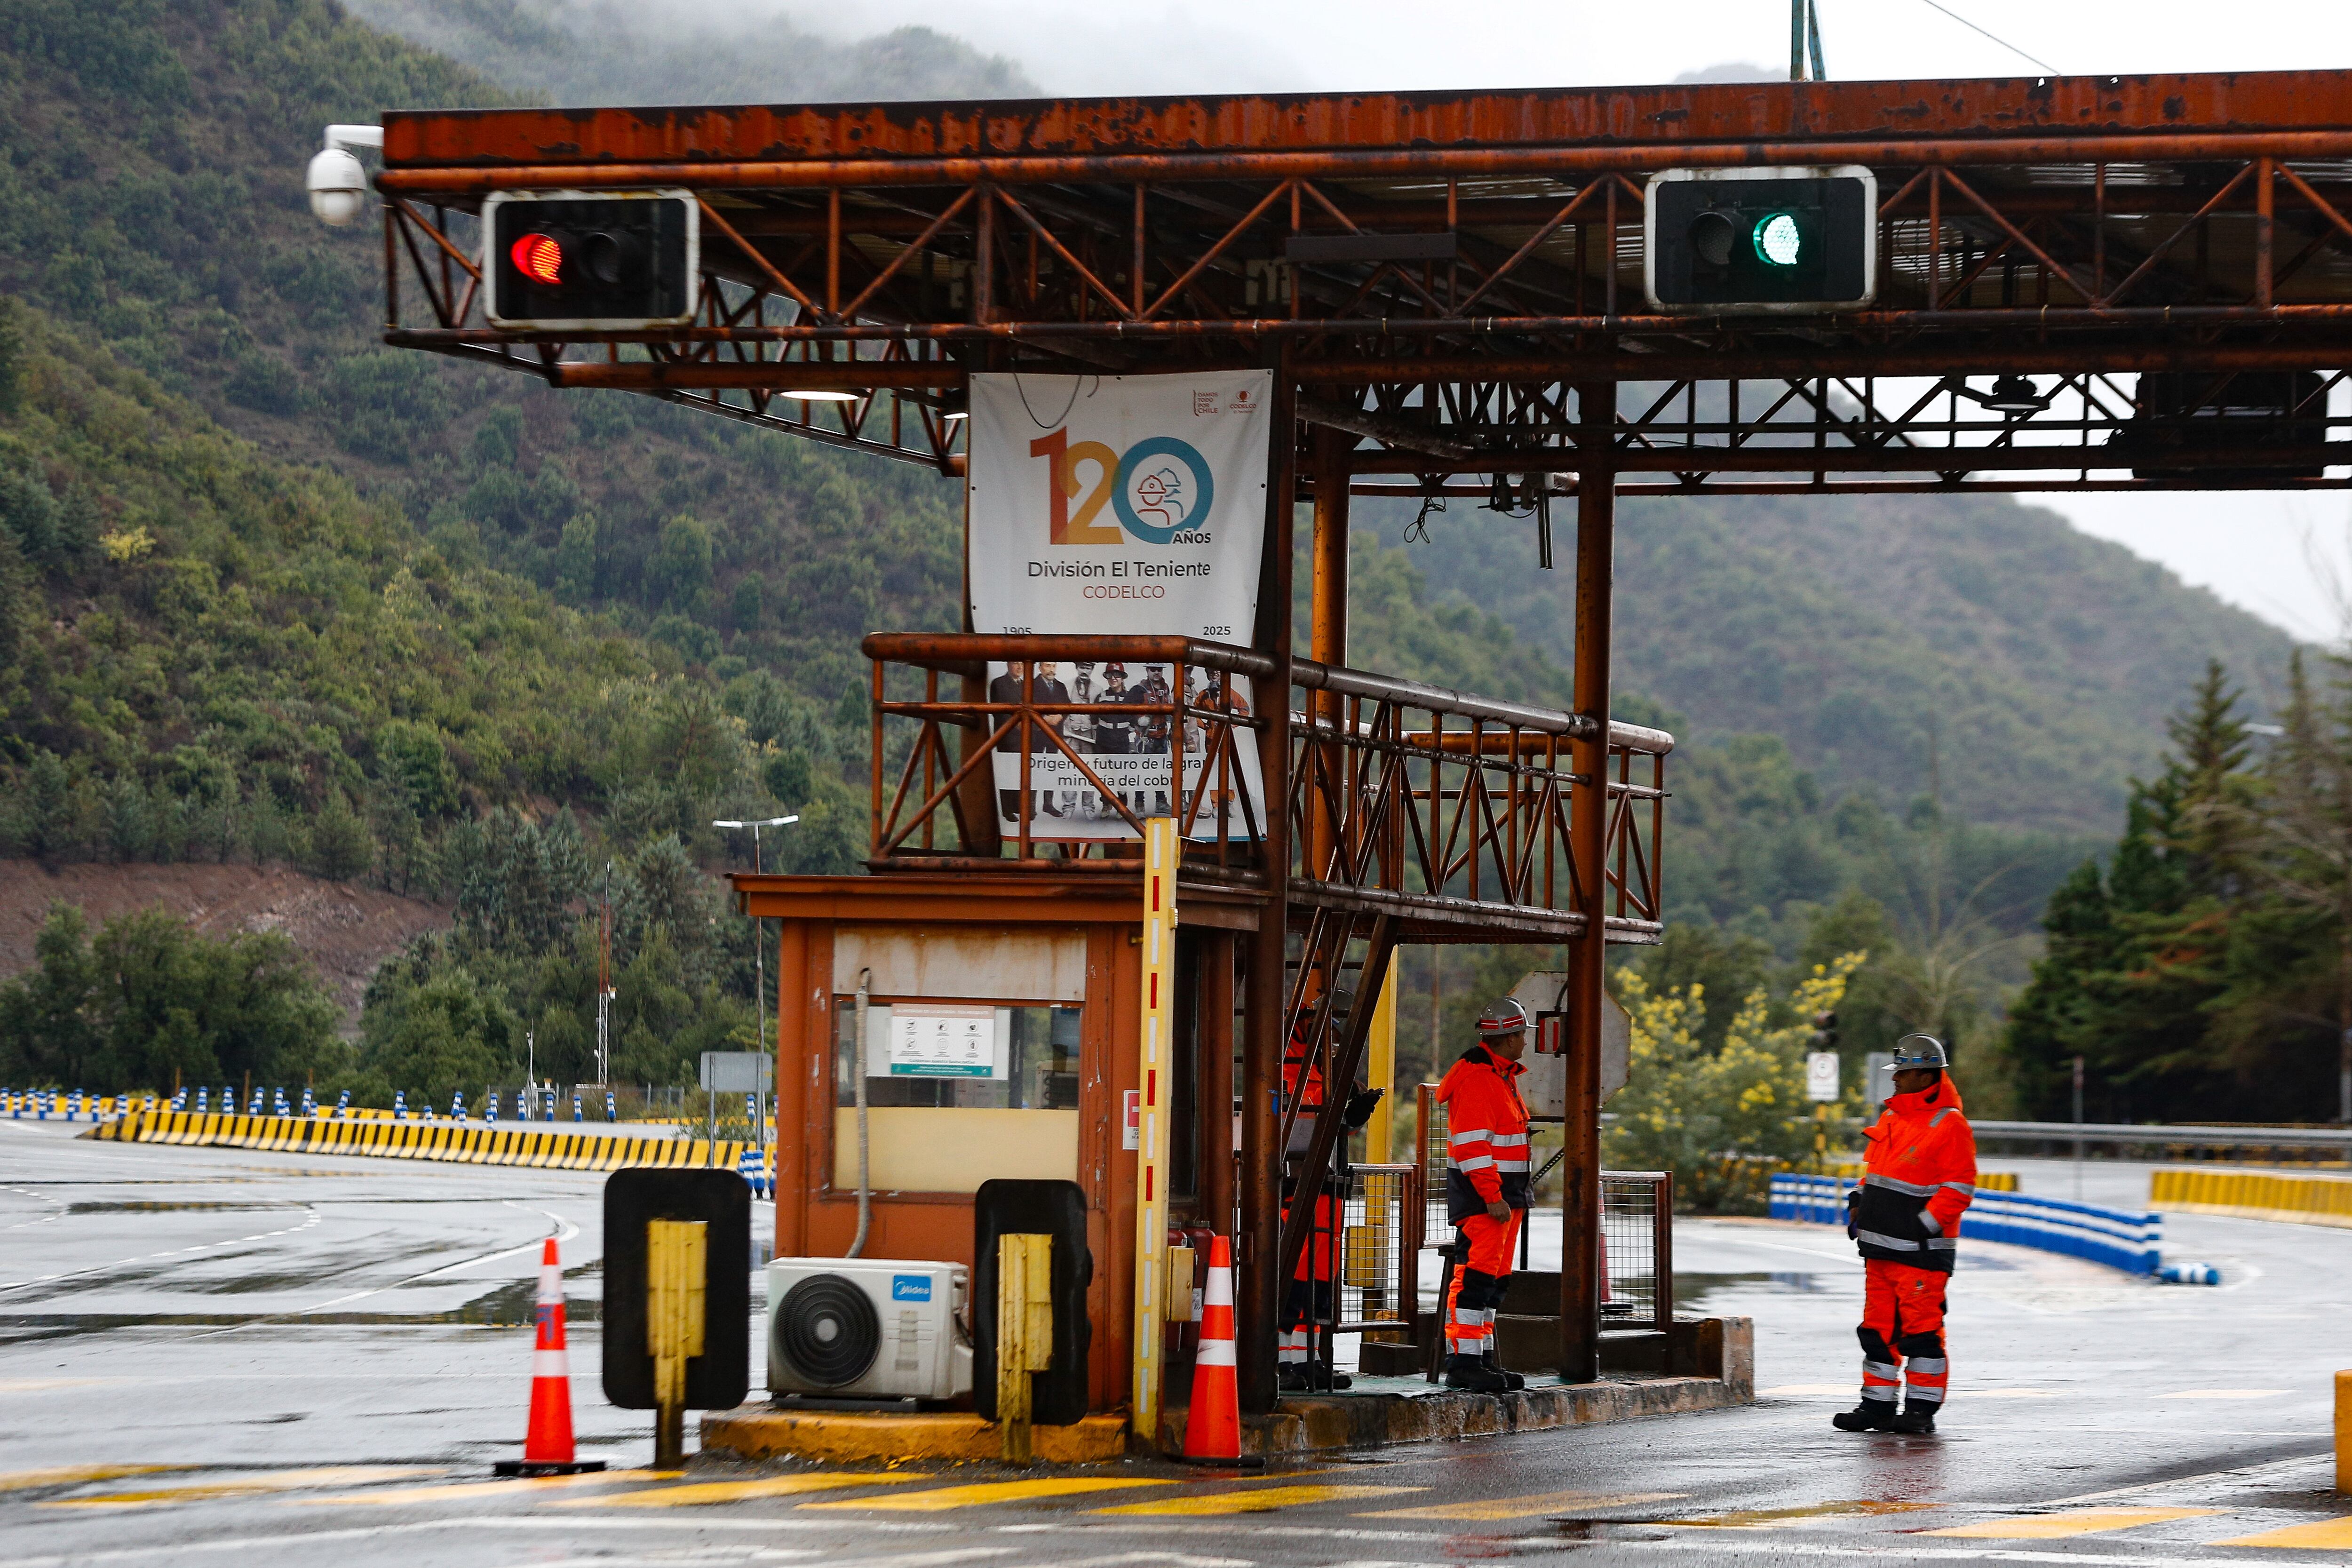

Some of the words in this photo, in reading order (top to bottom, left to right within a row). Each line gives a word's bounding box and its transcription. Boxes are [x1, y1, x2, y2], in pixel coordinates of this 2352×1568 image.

[1031, 426, 1214, 544] 120
[1173, 530, 1211, 544] AÑOS
[1028, 560, 1104, 577] División
[1112, 561, 1128, 577] El
[1133, 560, 1210, 577] Teniente
[1083, 585, 1165, 599] CODELCO
[1203, 626, 1231, 635] 2025
[1093, 758, 1137, 770] futuro
[1142, 758, 1158, 769] de
[1162, 757, 1172, 769] la
[1119, 774, 1140, 786] del
[897, 1283, 930, 1295] Midea
